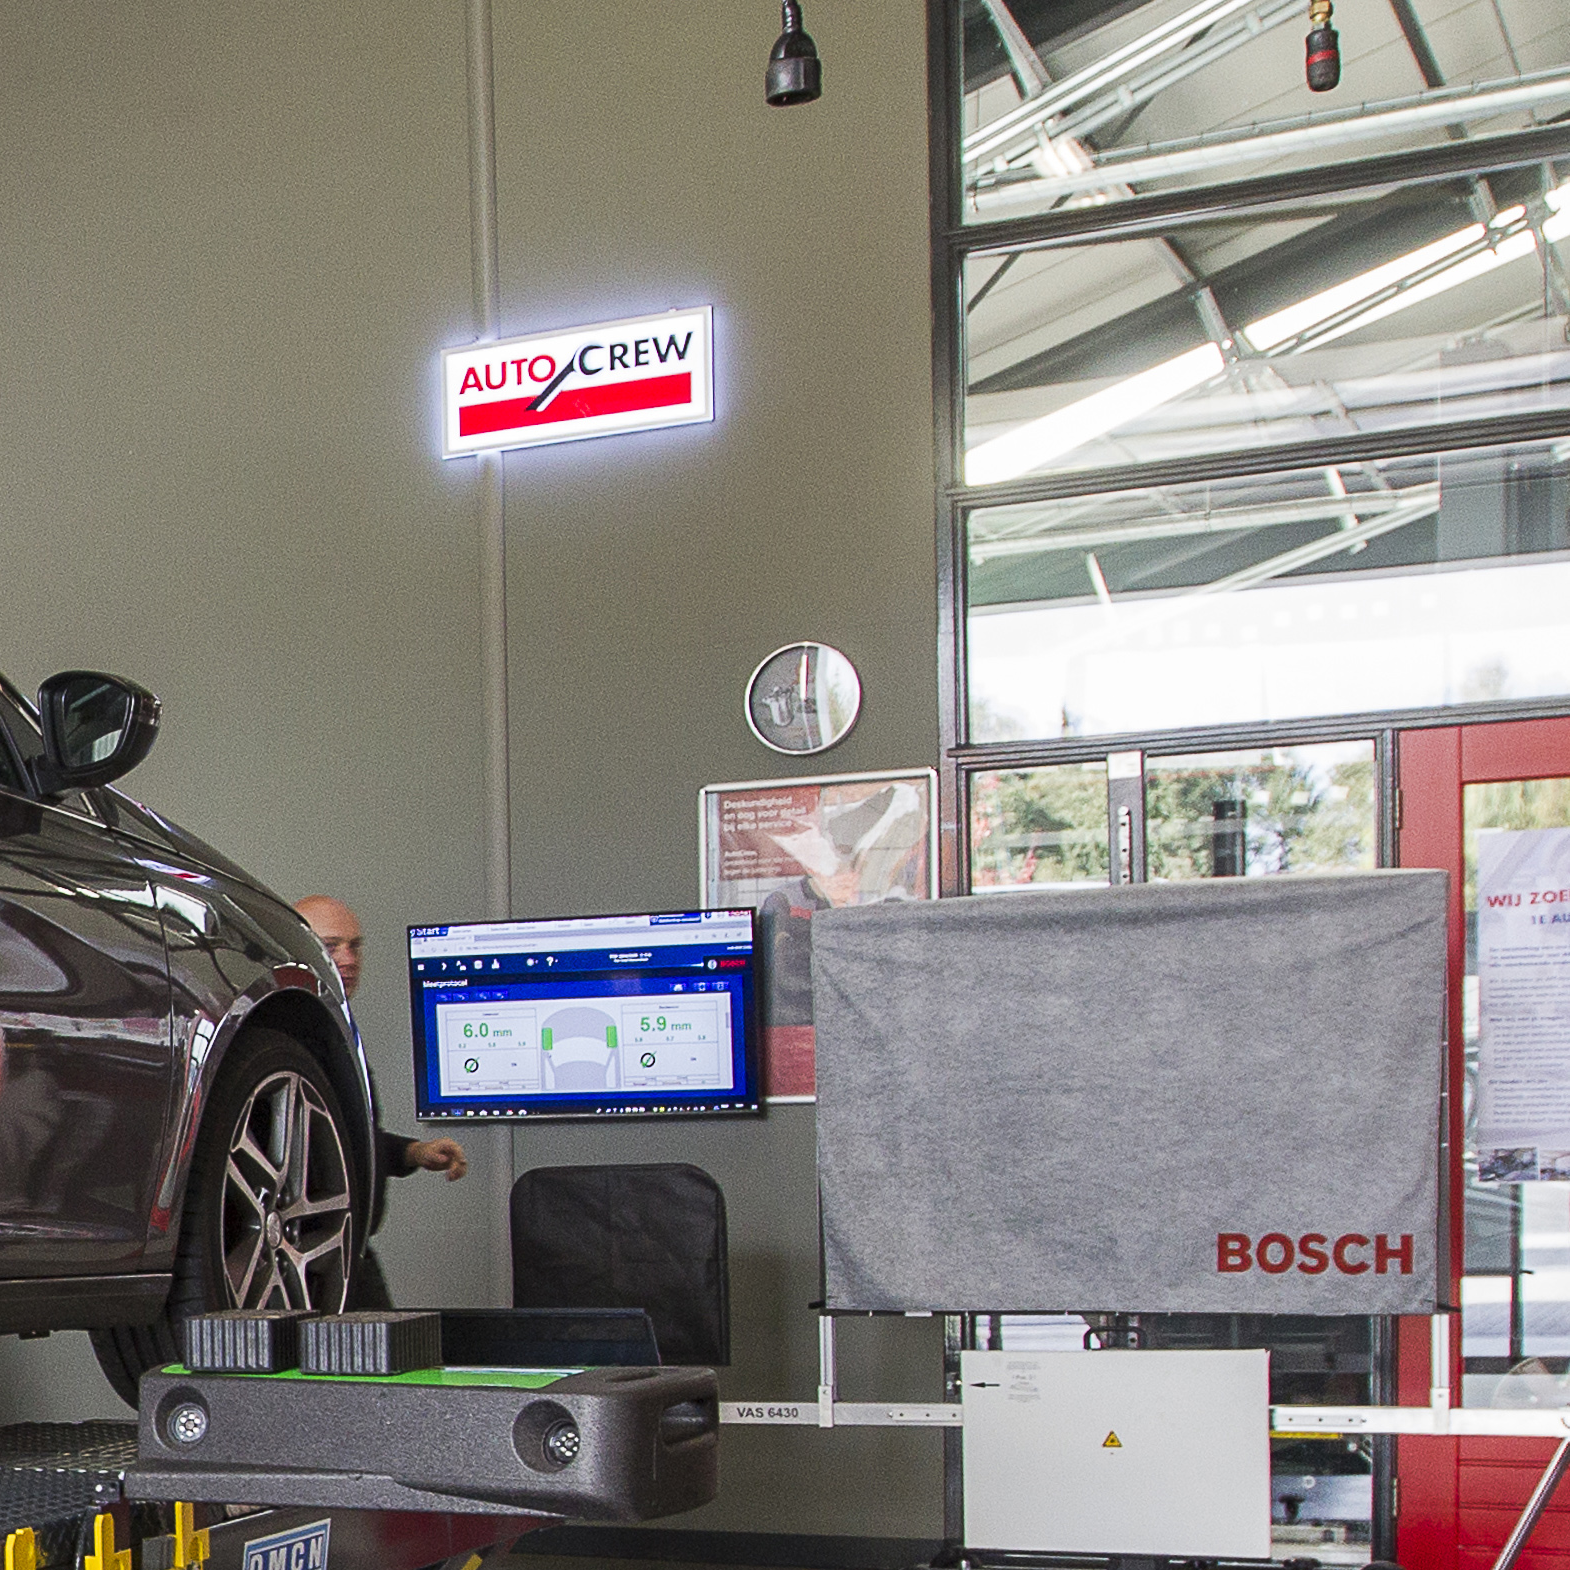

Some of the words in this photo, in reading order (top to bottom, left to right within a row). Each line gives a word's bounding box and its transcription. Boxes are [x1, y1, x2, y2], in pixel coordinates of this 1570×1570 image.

[459, 354, 556, 395] AUTO
[578, 331, 693, 376] CREW
[1486, 893, 1523, 909] WIJ
[1529, 888, 1570, 905] ZOE
[463, 1022, 489, 1039] 6.0
[492, 1028, 513, 1038] mm
[640, 1015, 667, 1032] 5.9
[671, 1021, 693, 1031] mm
[1217, 1232, 1414, 1275] BOSCH
[736, 1407, 764, 1418] VAS
[767, 1407, 799, 1418] 6430
